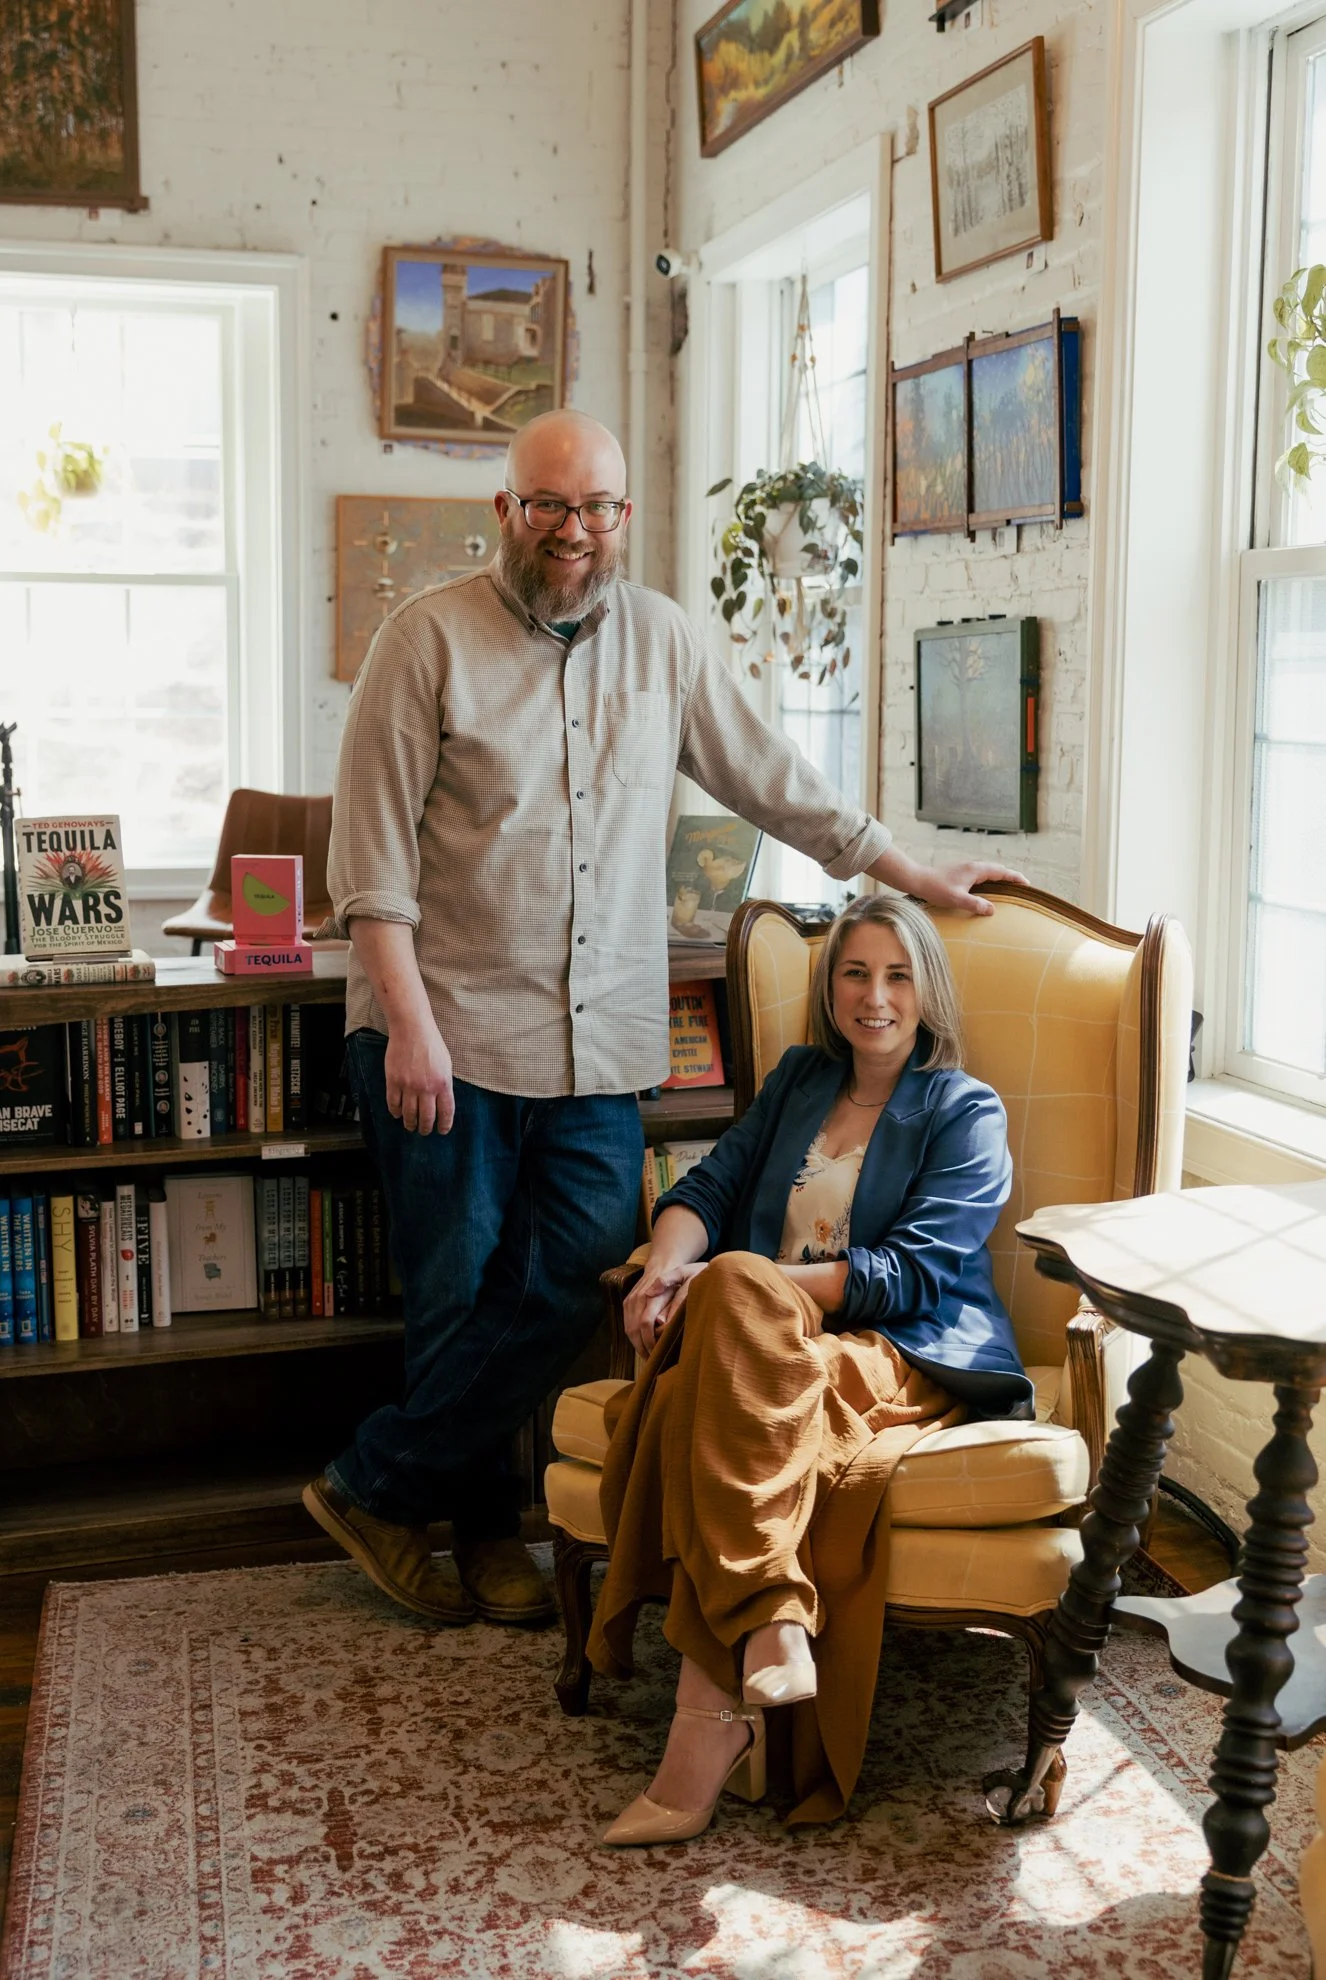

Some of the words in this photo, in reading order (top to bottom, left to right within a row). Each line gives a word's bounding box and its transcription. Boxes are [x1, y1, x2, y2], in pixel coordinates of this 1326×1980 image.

[32, 821, 50, 829] TED
[51, 820, 106, 828] GENOWAYS
[22, 829, 117, 853] TEQUILA
[27, 890, 123, 927] WARS
[30, 926, 59, 937] JOSE
[63, 925, 112, 936] CUERVO
[49, 934, 82, 943] BLOODY
[84, 932, 125, 940] STRUGGLE
[64, 940, 84, 948] SPIRIT
[97, 938, 123, 946] MEXICO
[245, 953, 303, 967] TEQUILA
[270, 1020, 280, 1039] Price
[290, 1012, 301, 1048] DYNAMITE!
[688, 1015, 709, 1028] FIRE
[674, 1035, 707, 1045] AMERICAN
[81, 1038, 90, 1080] HARRISON
[268, 1043, 280, 1066] Maybe
[115, 1066, 126, 1095] ELLIOT
[290, 1059, 301, 1094] NIETZSCHE
[270, 1086, 280, 1105] Make
[14, 1104, 53, 1119] BRAVE
[116, 1098, 126, 1119] PAGE
[13, 1213, 22, 1231] THE
[52, 1206, 72, 1253] SHY
[0, 1215, 10, 1258] WRITTEN
[22, 1213, 33, 1256] WRITTEN
[88, 1225, 96, 1250] SYLVIA
[137, 1222, 149, 1265] FIVE
[14, 1233, 23, 1272] WATERS
[2, 1260, 10, 1272] IN
[24, 1258, 33, 1270] IN
[89, 1252, 97, 1277] PLATH
[91, 1295, 98, 1306] BY
[91, 1307, 99, 1323] DAY
